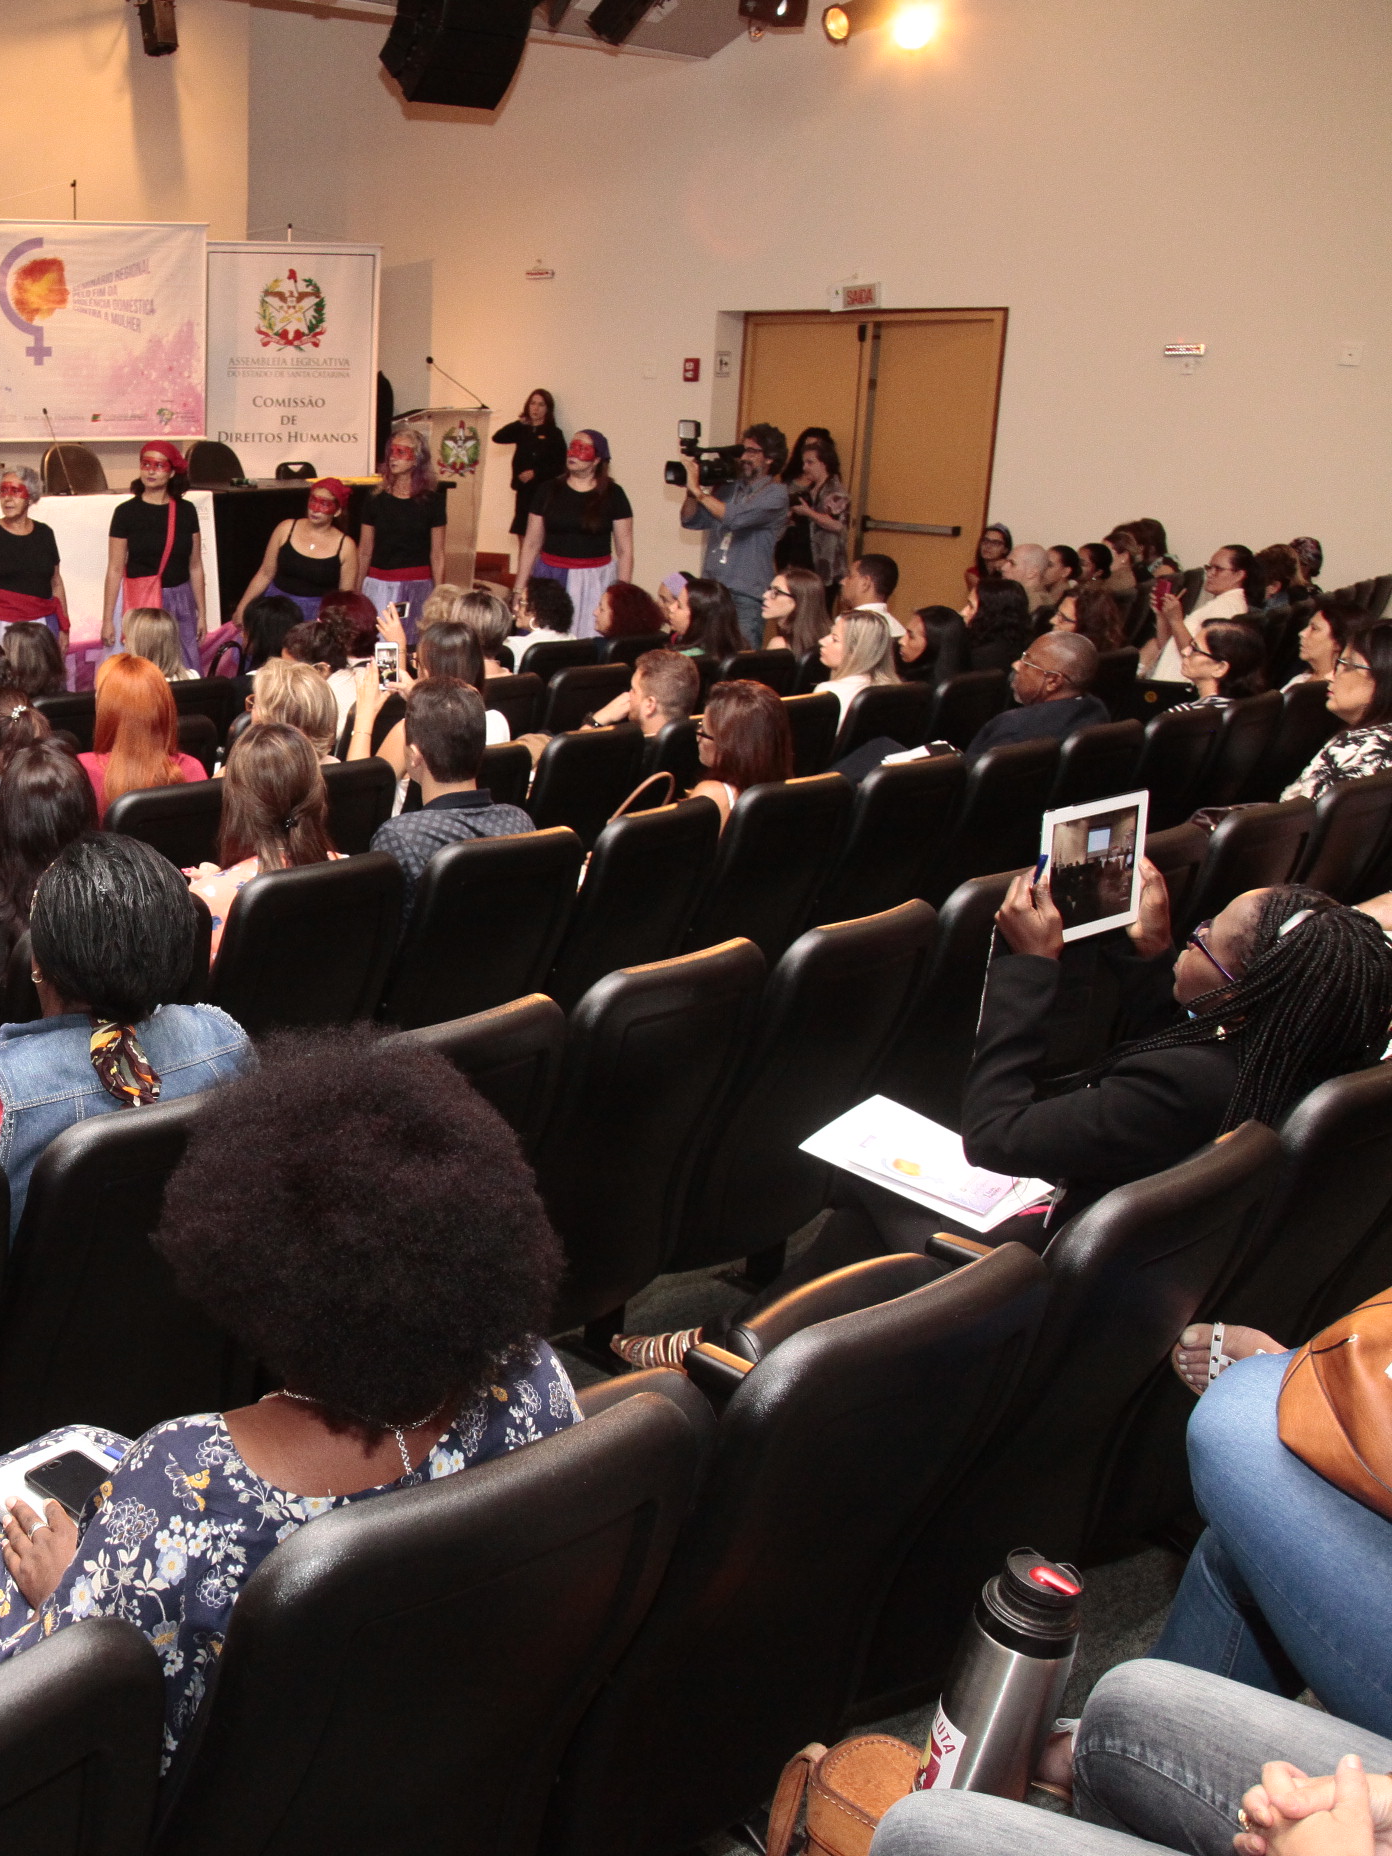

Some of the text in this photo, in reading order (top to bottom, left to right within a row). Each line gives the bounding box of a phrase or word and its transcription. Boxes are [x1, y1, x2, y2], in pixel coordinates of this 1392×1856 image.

[111, 312, 141, 333] MULHER
[228, 357, 350, 367] ASSEMBLEIA LEGISLATIVA
[281, 415, 298, 425] DE
[218, 431, 358, 443] DIREITOS HUMANOS
